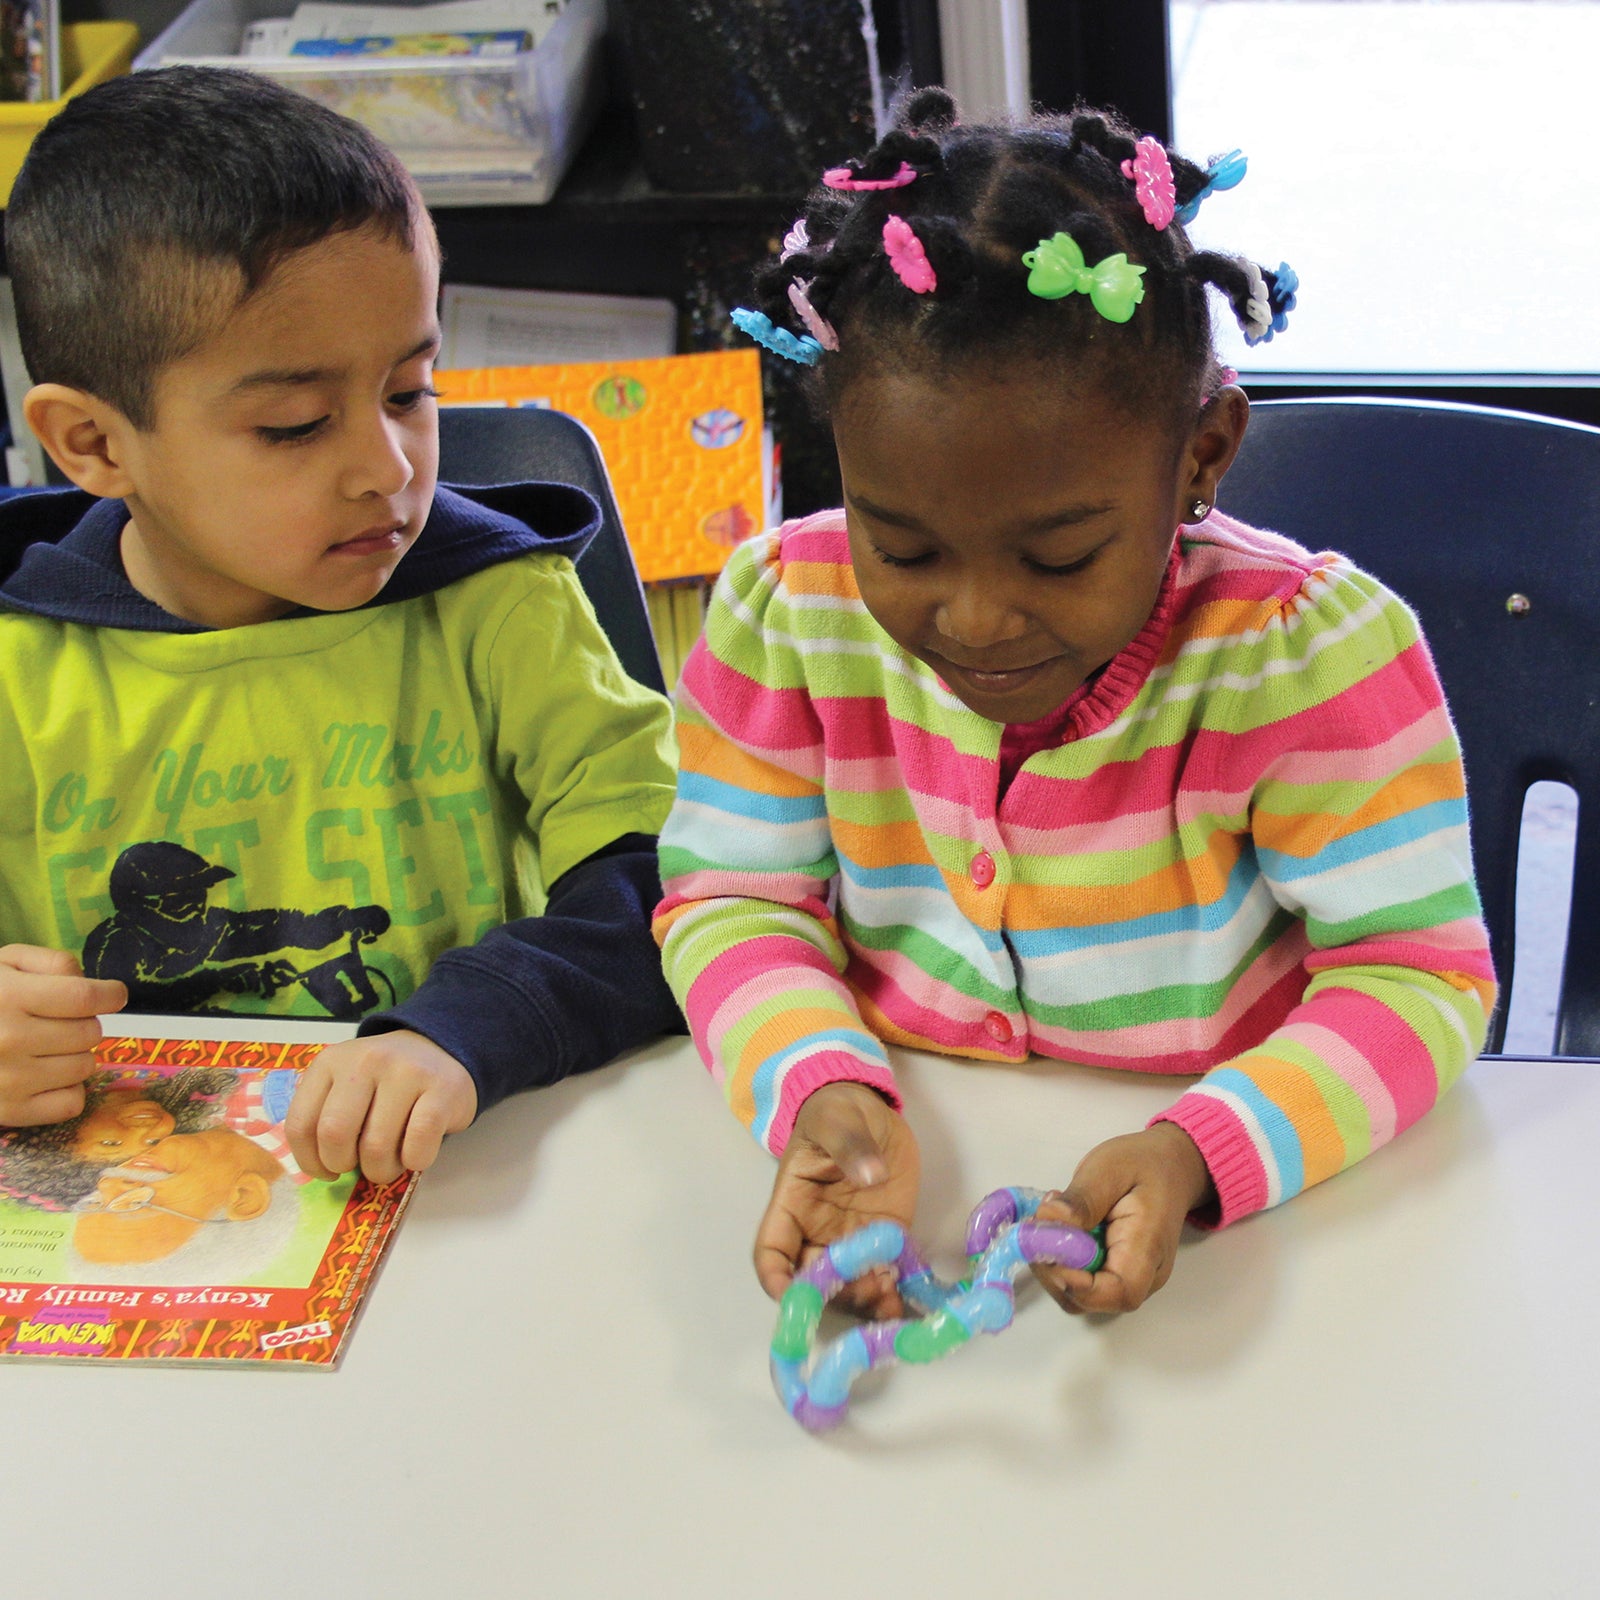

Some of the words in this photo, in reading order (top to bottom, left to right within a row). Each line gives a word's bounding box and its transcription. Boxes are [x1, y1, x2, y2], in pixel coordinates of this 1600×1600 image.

[42, 771, 122, 834] On
[153, 743, 293, 838] Your
[321, 709, 473, 790] Maks
[47, 816, 260, 950] GT
[304, 787, 492, 928] SET
[35, 1286, 144, 1307] Family
[150, 1287, 274, 1308] Kenya's
[16, 1321, 115, 1345] KENYA
[265, 1323, 328, 1347] TYCO
